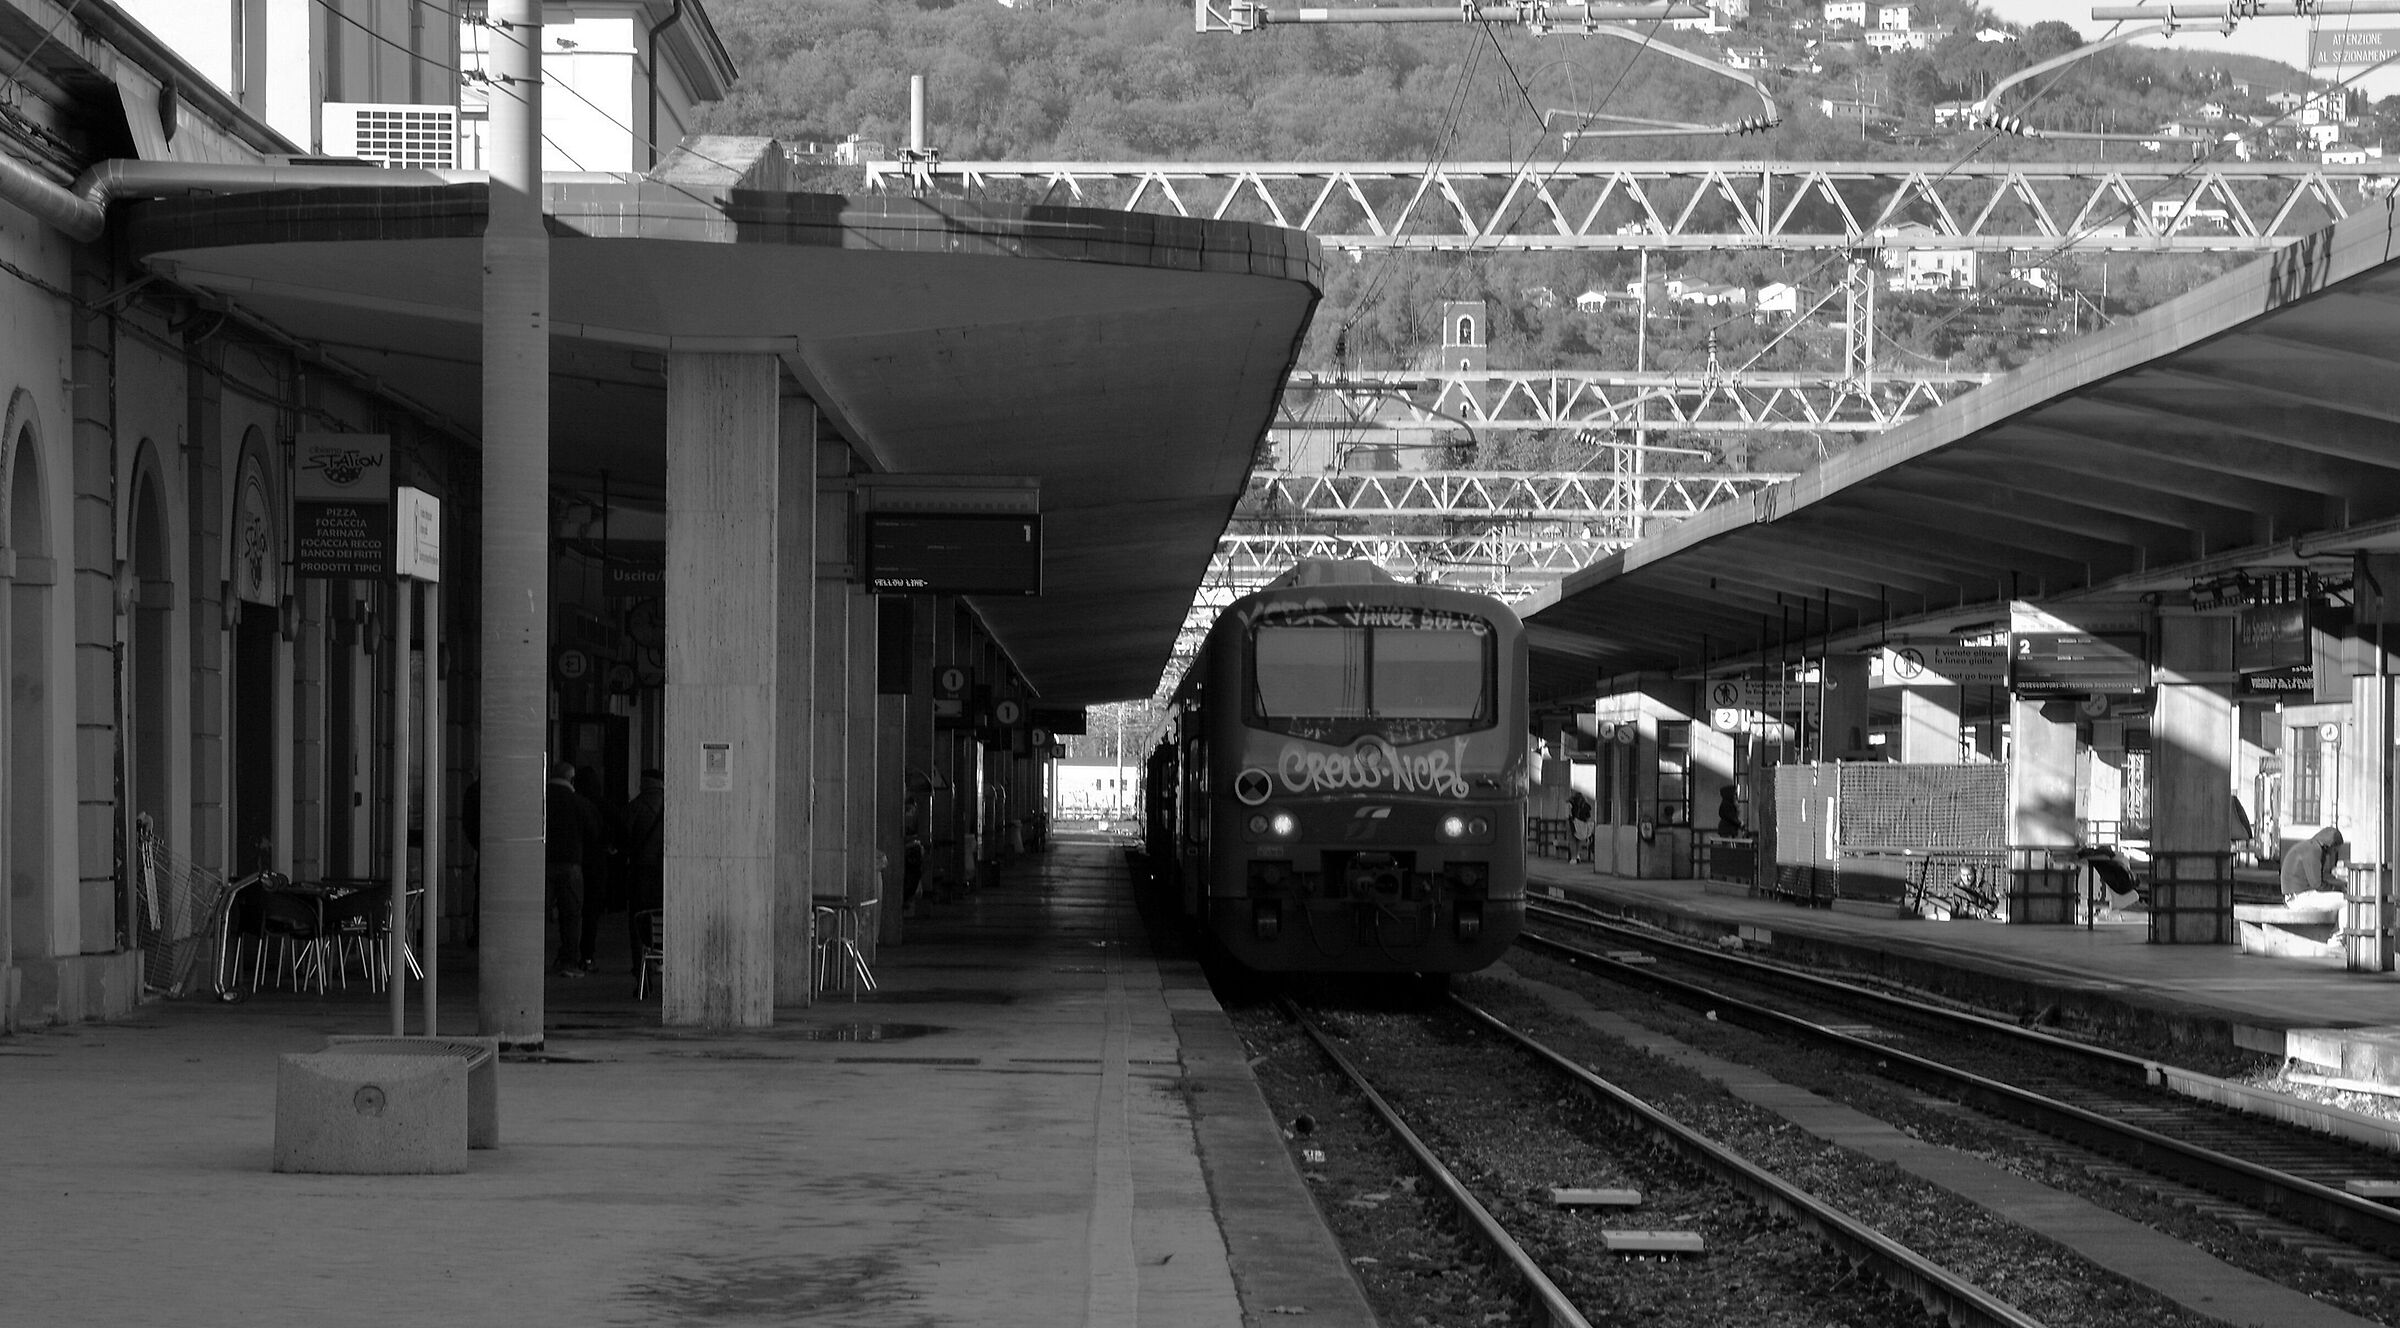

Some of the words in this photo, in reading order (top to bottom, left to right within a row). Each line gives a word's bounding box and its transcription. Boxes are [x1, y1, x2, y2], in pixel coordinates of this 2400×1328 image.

[2318, 51, 2328, 63] AL
[326, 507, 357, 517] PIZZA
[315, 518, 367, 528] FOCACCIA
[317, 529, 366, 538] FARINATA
[1024, 525, 1031, 542] 1
[301, 538, 348, 548] FOCACCIA
[351, 539, 382, 549] RECCO
[301, 549, 335, 559] BANCO
[337, 550, 352, 559] DEI
[354, 550, 382, 560] FRITTI
[300, 562, 351, 572] PRODOTTI
[354, 563, 382, 573] TIPICI
[2020, 639, 2030, 654] 2
[1935, 656, 1942, 664] la
[1945, 656, 1967, 664] linea
[1969, 656, 1993, 666] gialla
[951, 673, 956, 687] 1
[1934, 671, 1946, 679] Do
[1005, 707, 1010, 720] 1
[1723, 712, 1731, 723] 2
